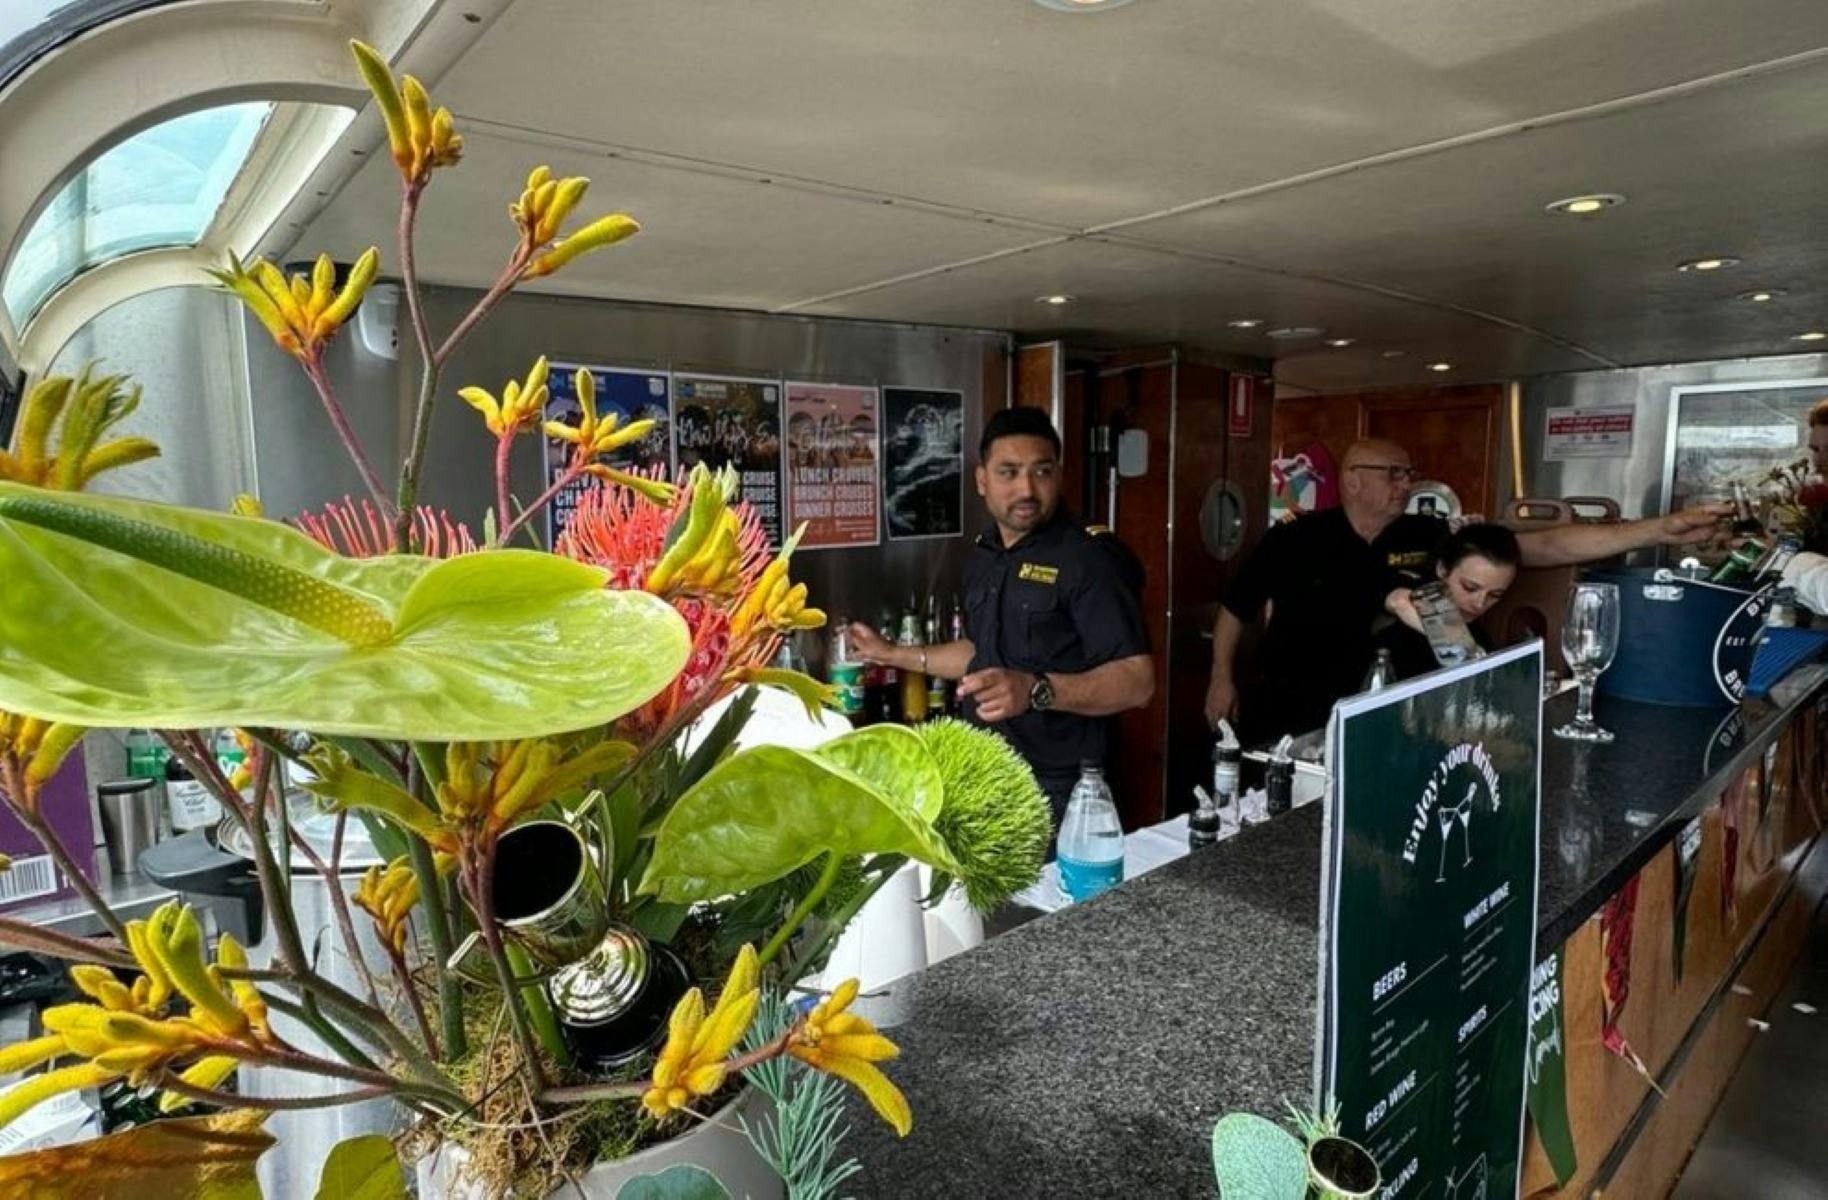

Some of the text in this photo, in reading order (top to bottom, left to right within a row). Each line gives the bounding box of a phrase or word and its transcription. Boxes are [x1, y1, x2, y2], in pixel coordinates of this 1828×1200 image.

[1403, 770, 1439, 864] Enjoy
[1372, 960, 1407, 1001] BEERS
[1365, 1098, 1387, 1132] RED
[1388, 1069, 1417, 1107] WINE
